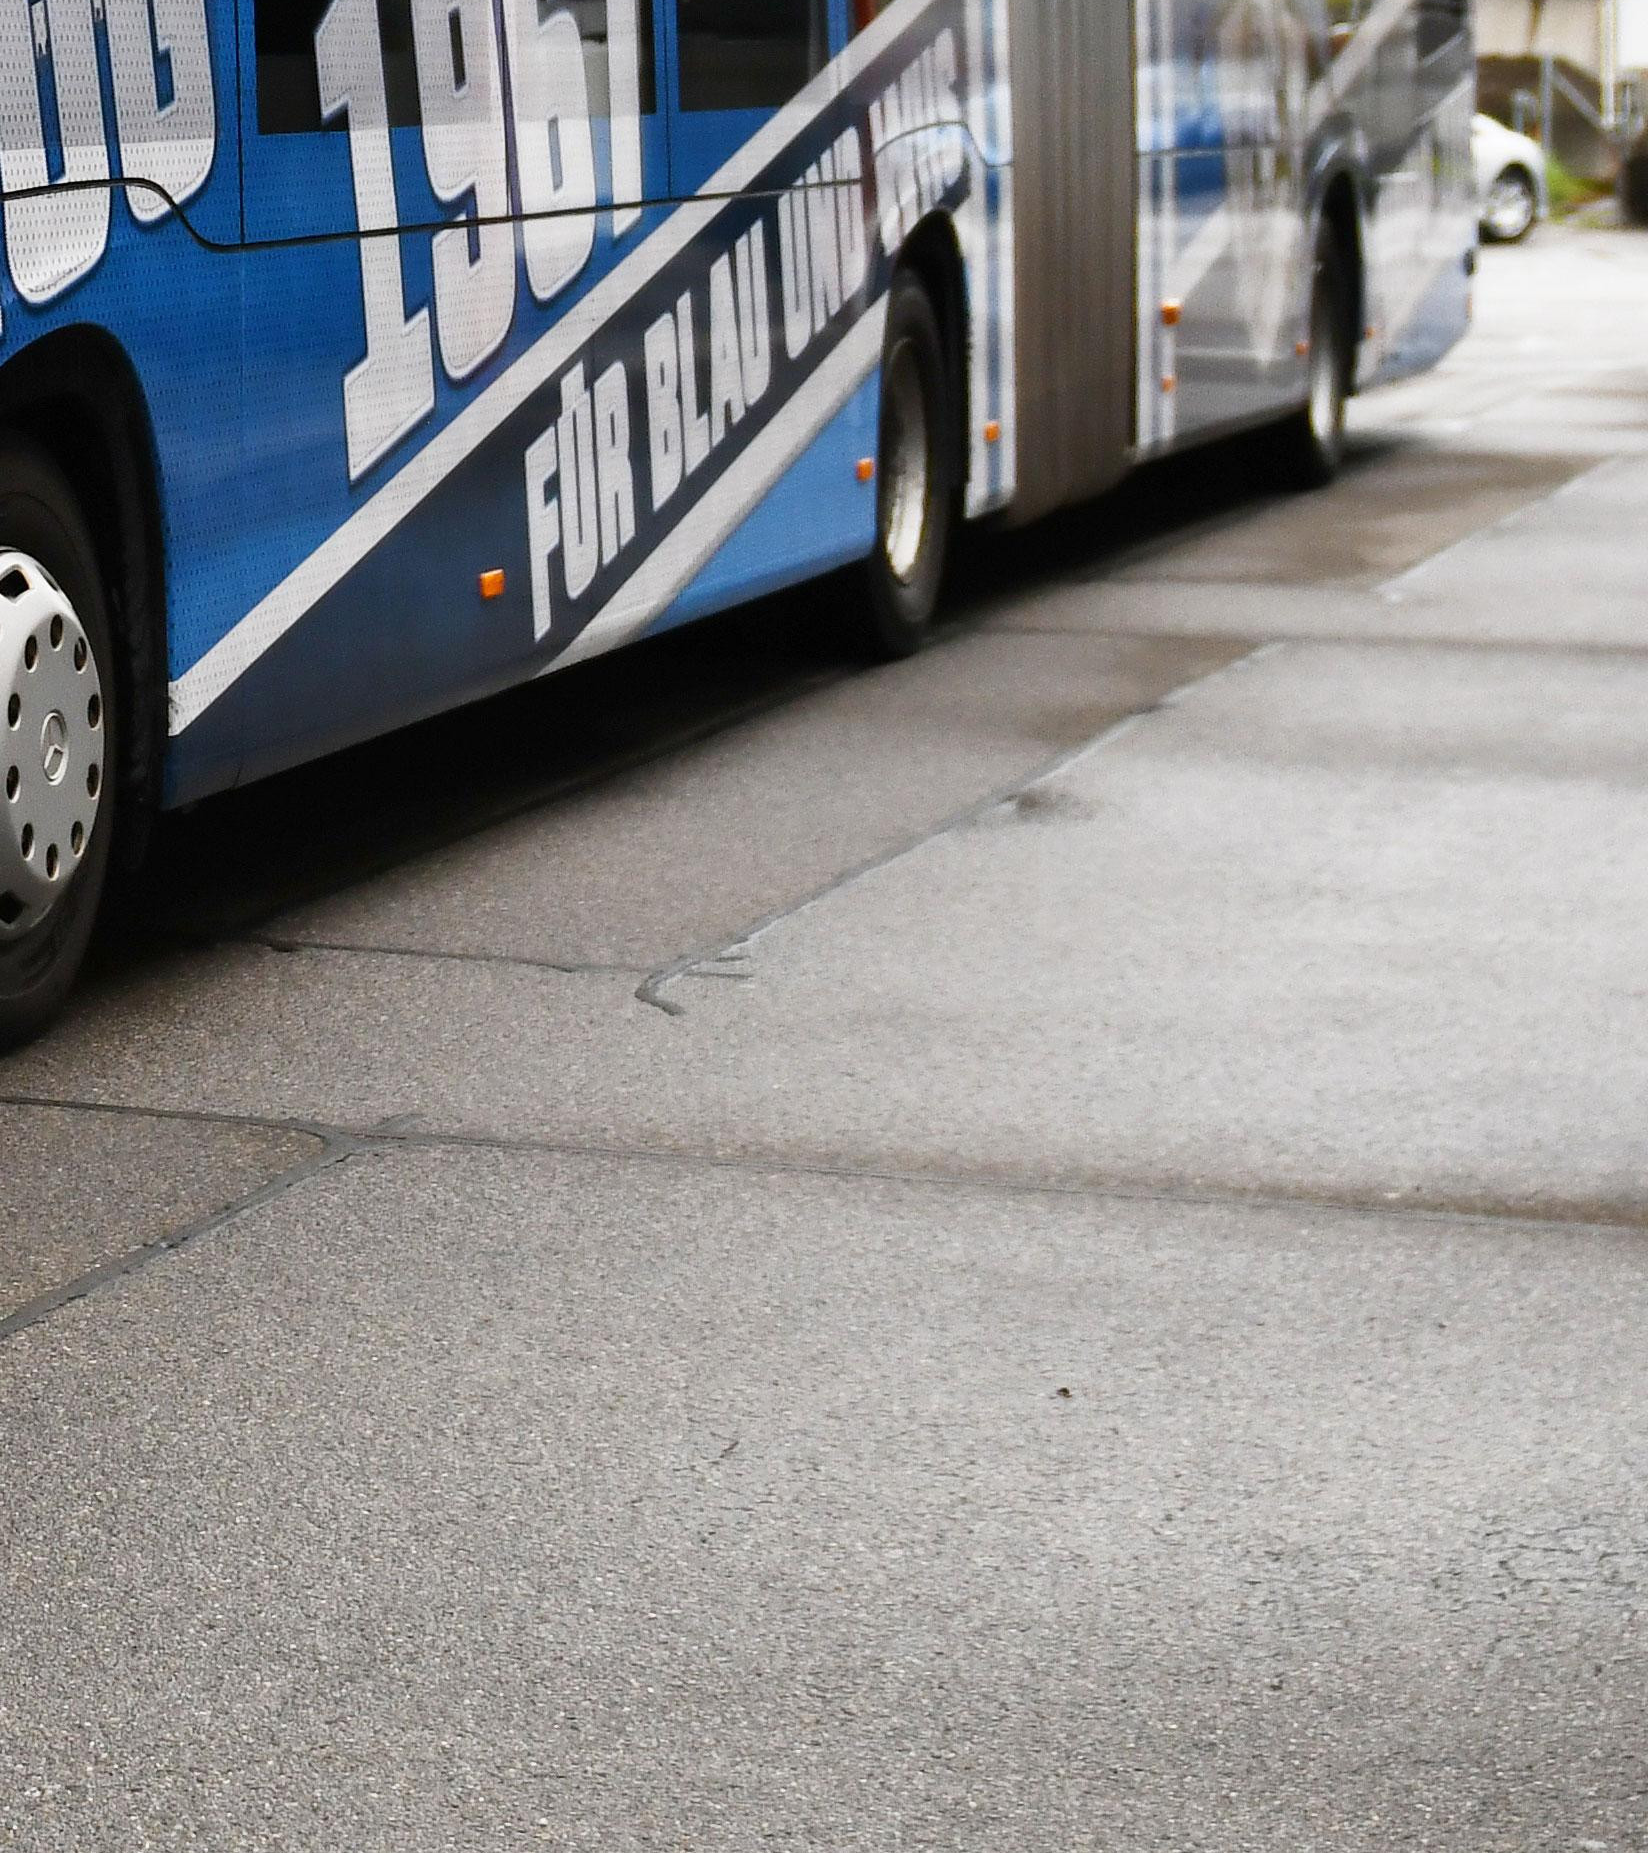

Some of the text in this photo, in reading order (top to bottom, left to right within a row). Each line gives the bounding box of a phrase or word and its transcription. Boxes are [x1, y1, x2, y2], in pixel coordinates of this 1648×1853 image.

[523, 361, 635, 643] FÜR
[644, 219, 774, 513] BLAU
[778, 124, 866, 365] UND
